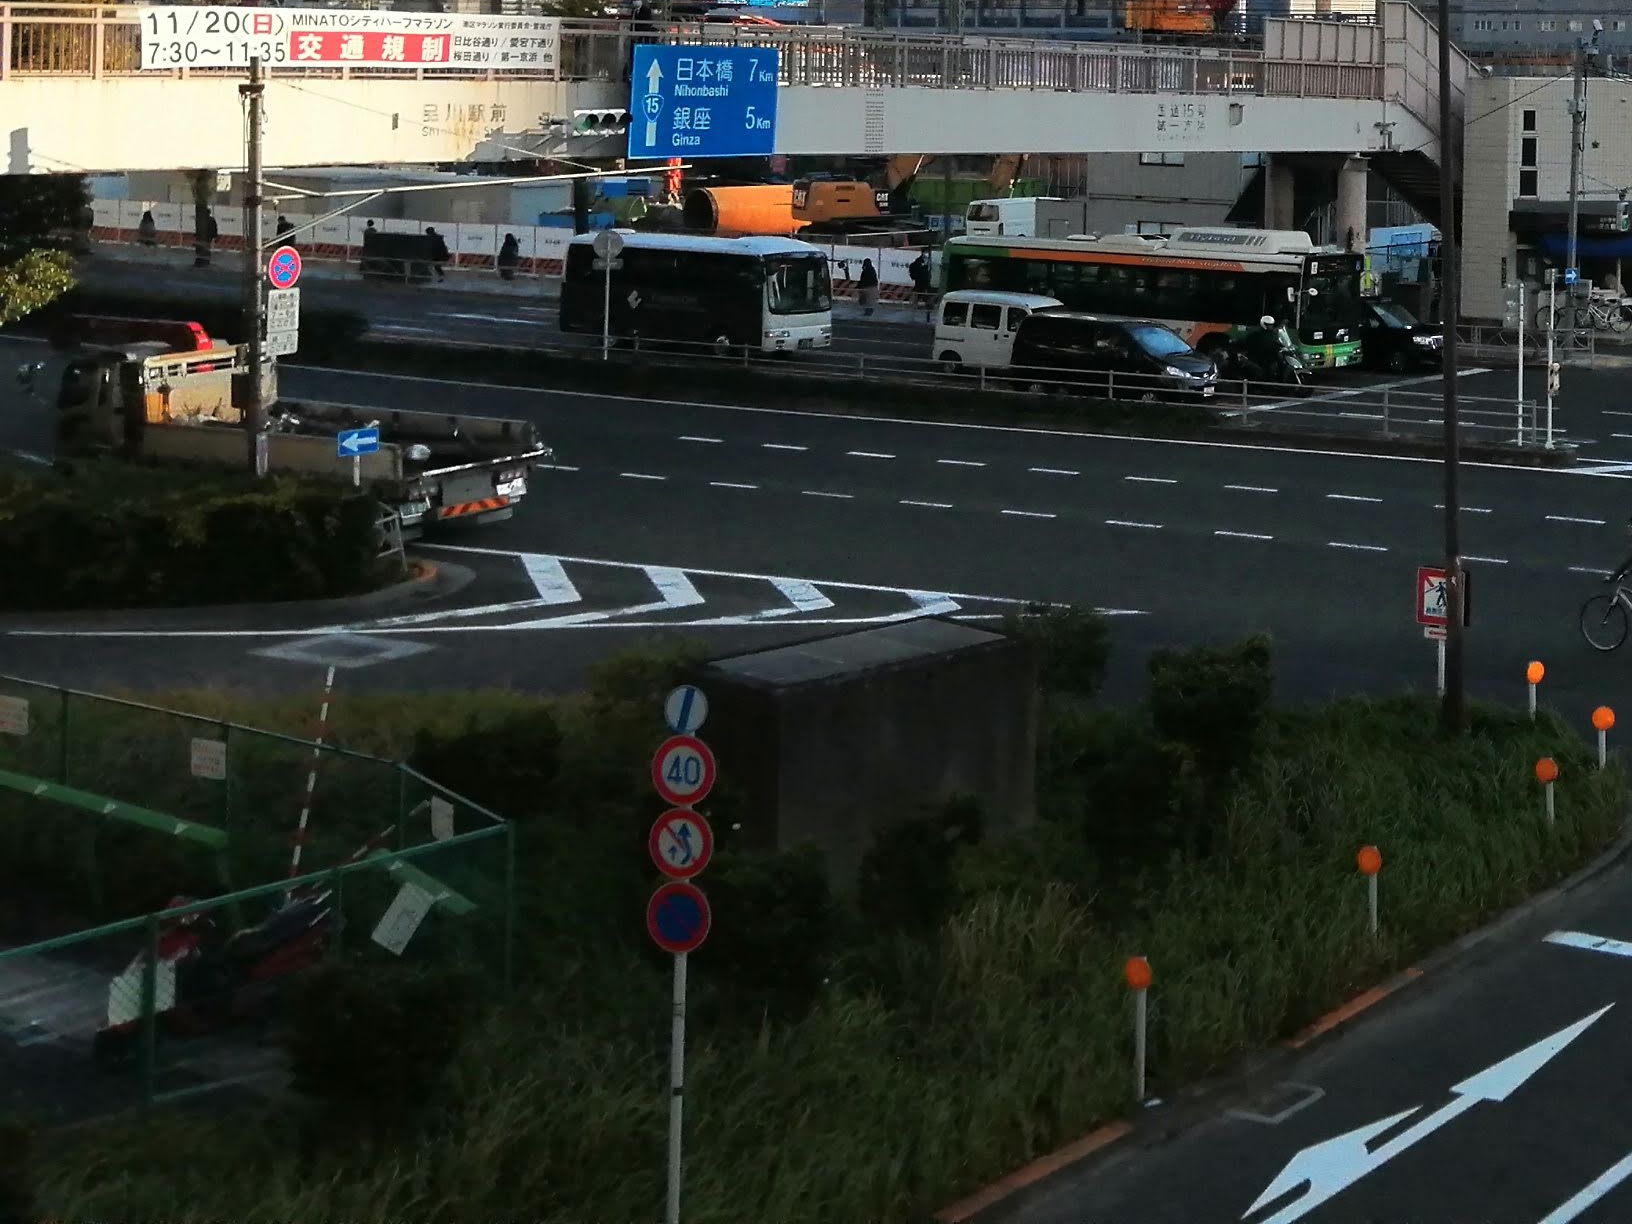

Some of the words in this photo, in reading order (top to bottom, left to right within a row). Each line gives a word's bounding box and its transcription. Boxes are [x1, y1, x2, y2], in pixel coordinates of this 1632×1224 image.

[292, 14, 453, 30] MINATOシティハーフマラソン
[298, 33, 445, 61] 交通規制
[676, 58, 733, 82] 日本橋
[674, 84, 729, 97] Nihonbashi
[645, 97, 659, 114] 15
[672, 107, 712, 130] 銀座
[672, 133, 701, 147] Ginza
[876, 192, 889, 202] CAT
[667, 755, 701, 785] 40
